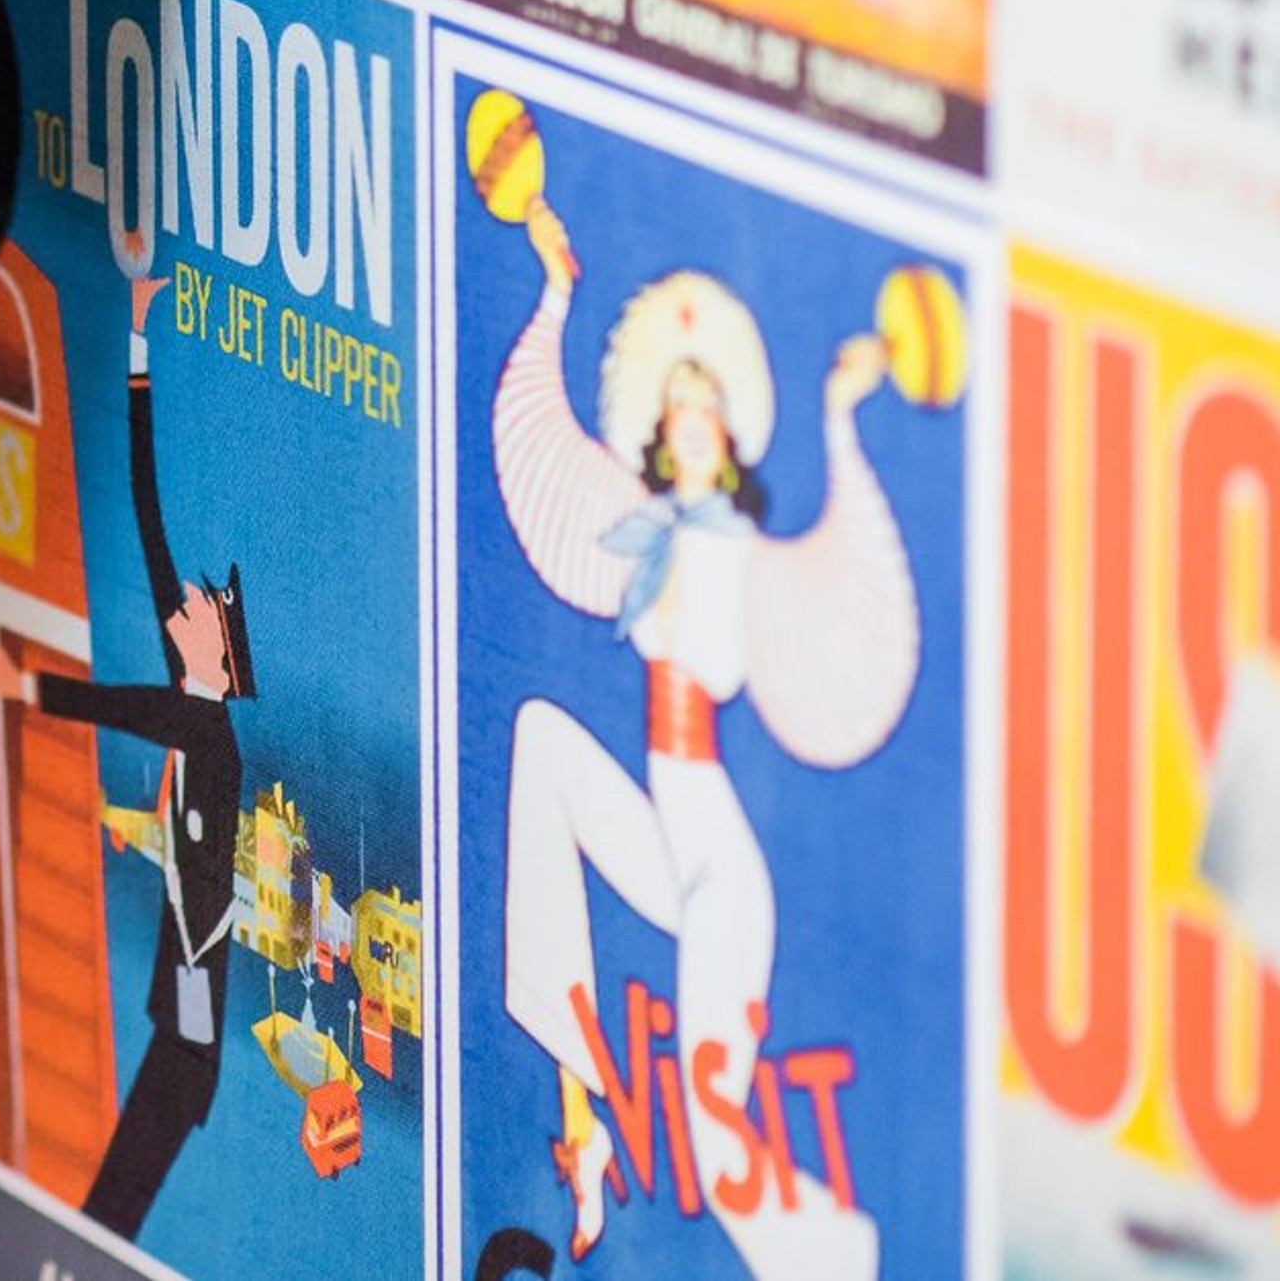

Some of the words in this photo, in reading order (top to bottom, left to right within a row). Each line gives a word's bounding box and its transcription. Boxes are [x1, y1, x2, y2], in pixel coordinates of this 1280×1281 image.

[35, 108, 66, 188] TO
[175, 261, 212, 341] BY
[217, 284, 268, 369] JET
[280, 308, 402, 429] CLIPPER
